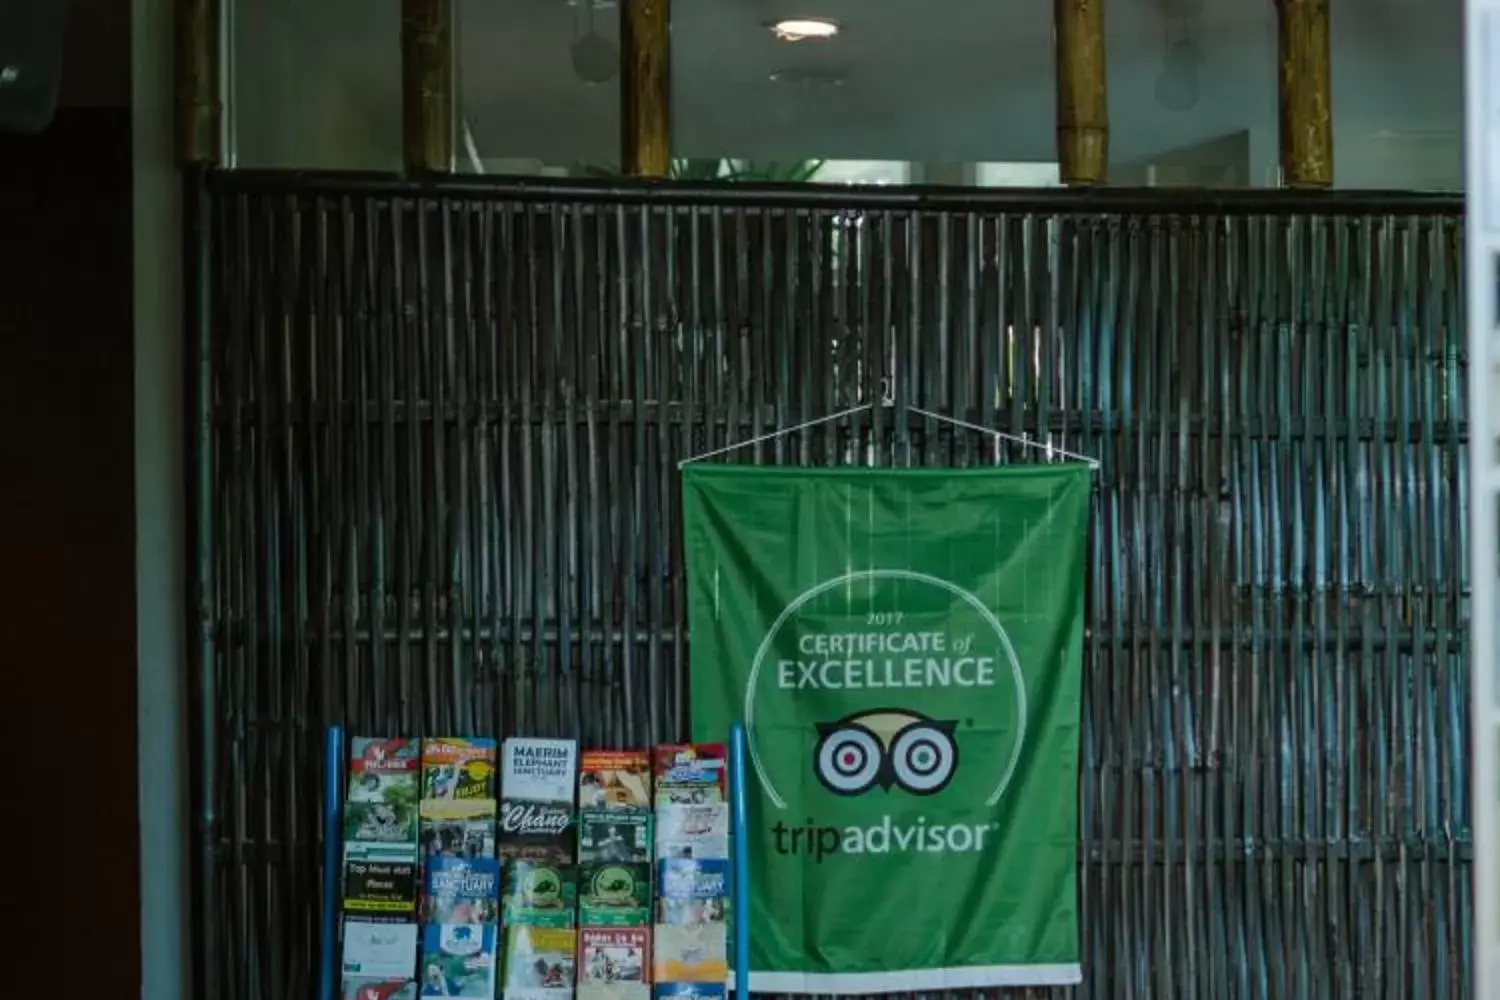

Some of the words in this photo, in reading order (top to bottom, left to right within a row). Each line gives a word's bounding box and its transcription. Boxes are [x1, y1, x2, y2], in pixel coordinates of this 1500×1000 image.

[866, 612, 904, 626] 2017
[799, 632, 946, 654] CERTIFICATE
[952, 632, 975, 656] of
[777, 656, 996, 690] EXCELLENCE
[513, 758, 569, 768] ELEPHANT
[772, 815, 990, 864] tripadvisor
